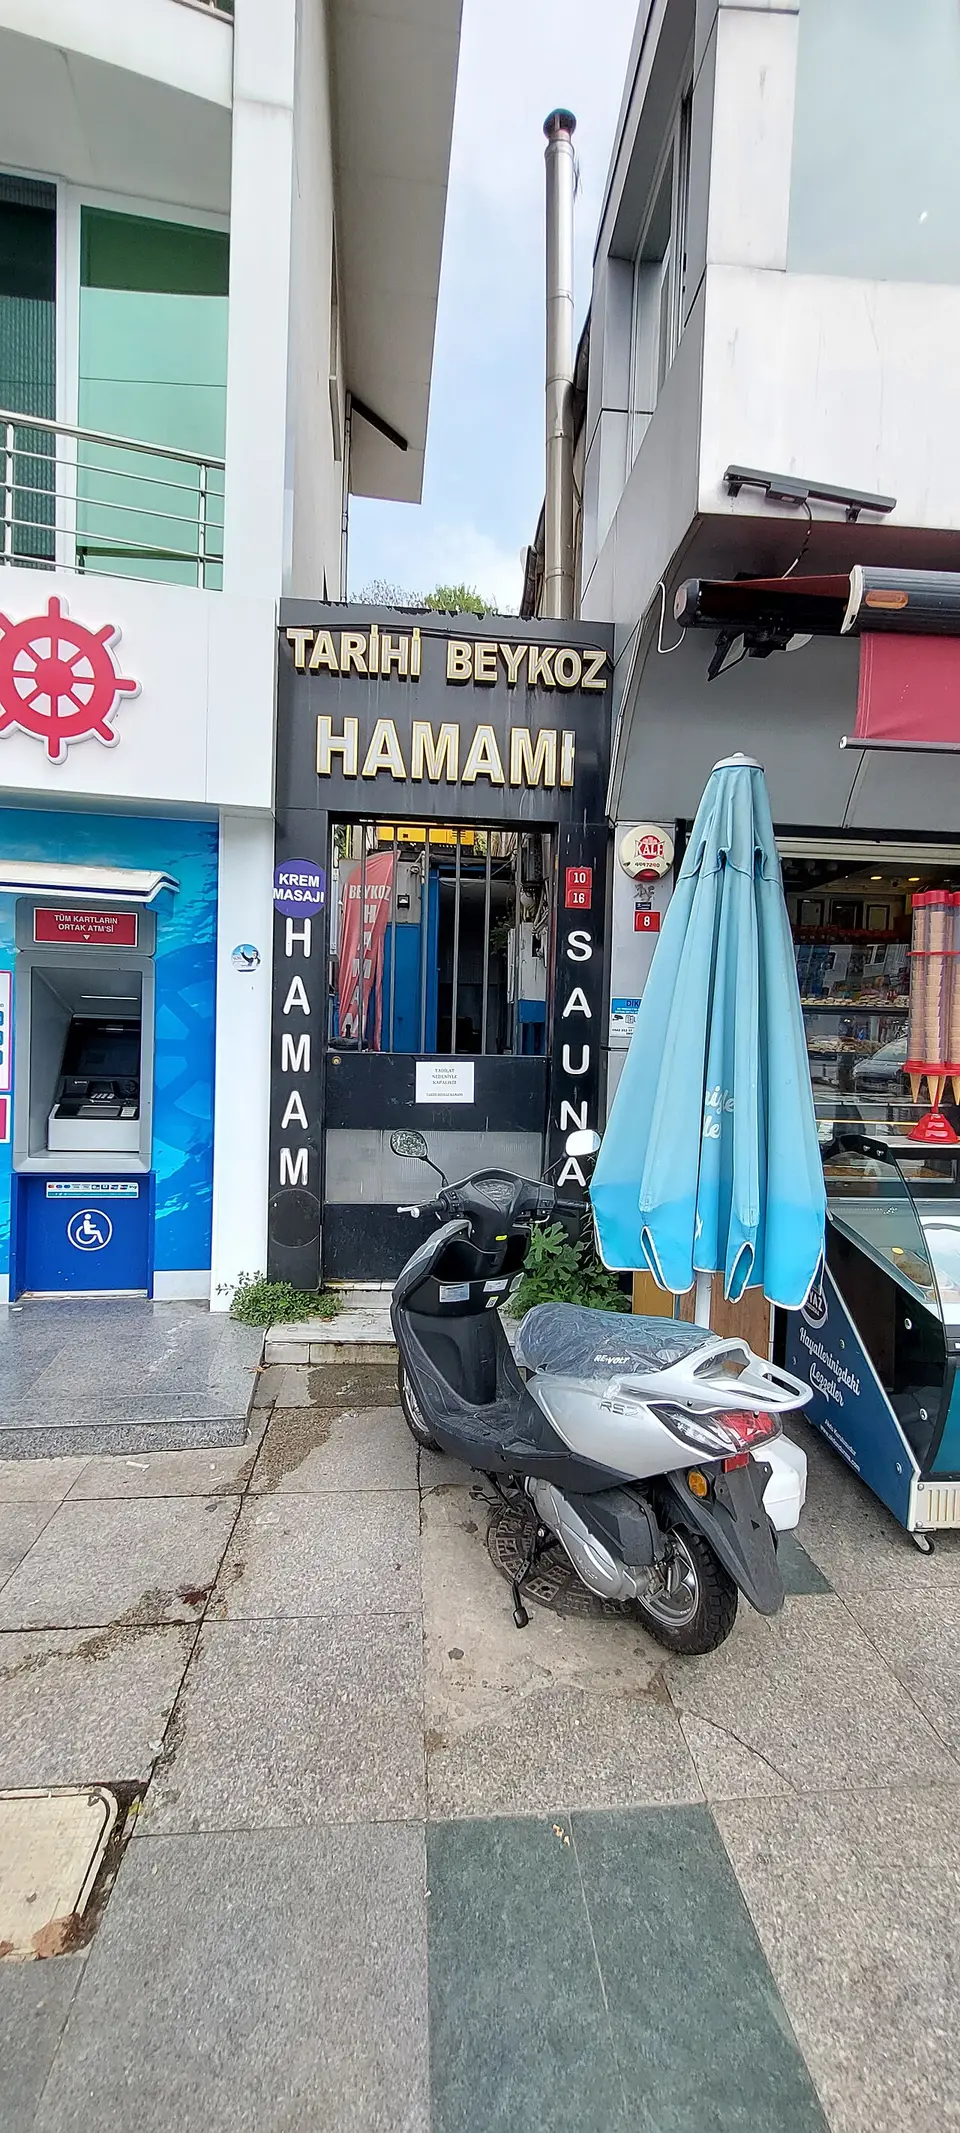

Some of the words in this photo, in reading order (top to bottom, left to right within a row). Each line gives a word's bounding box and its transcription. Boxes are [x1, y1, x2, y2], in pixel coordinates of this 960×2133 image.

[286, 624, 422, 677] TARİHİ
[446, 639, 608, 690] BEYKOZ
[315, 714, 577, 789] HAMAMI
[278, 872, 320, 888] KREM
[573, 872, 586, 884] 10
[272, 887, 325, 903] MASAJI
[572, 892, 585, 904] 16
[54, 914, 72, 922] TÜM
[73, 916, 118, 925] KARTLARIN
[58, 923, 86, 931] ORTAK
[643, 915, 651, 927] 8
[278, 916, 312, 1187] HAMAM
[555, 929, 593, 1189] SAUNA
